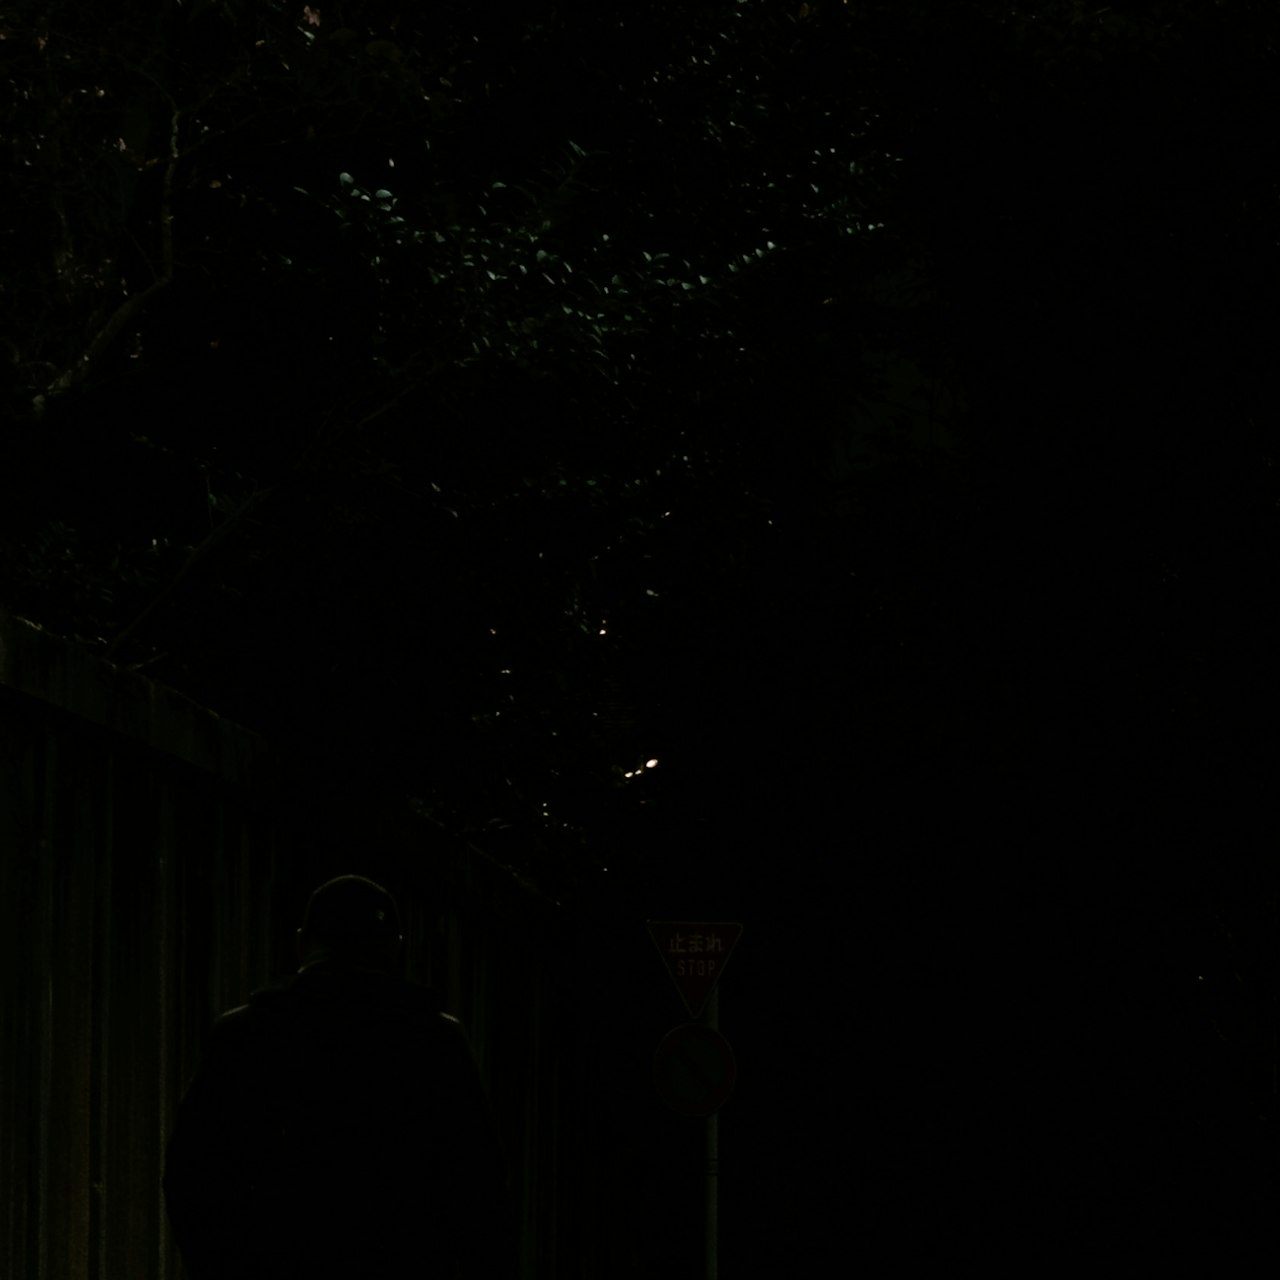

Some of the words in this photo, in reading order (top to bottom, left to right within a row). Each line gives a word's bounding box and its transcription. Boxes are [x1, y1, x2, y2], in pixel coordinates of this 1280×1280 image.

[667, 931, 726, 953] 止まれ
[677, 959, 716, 976] STOP
